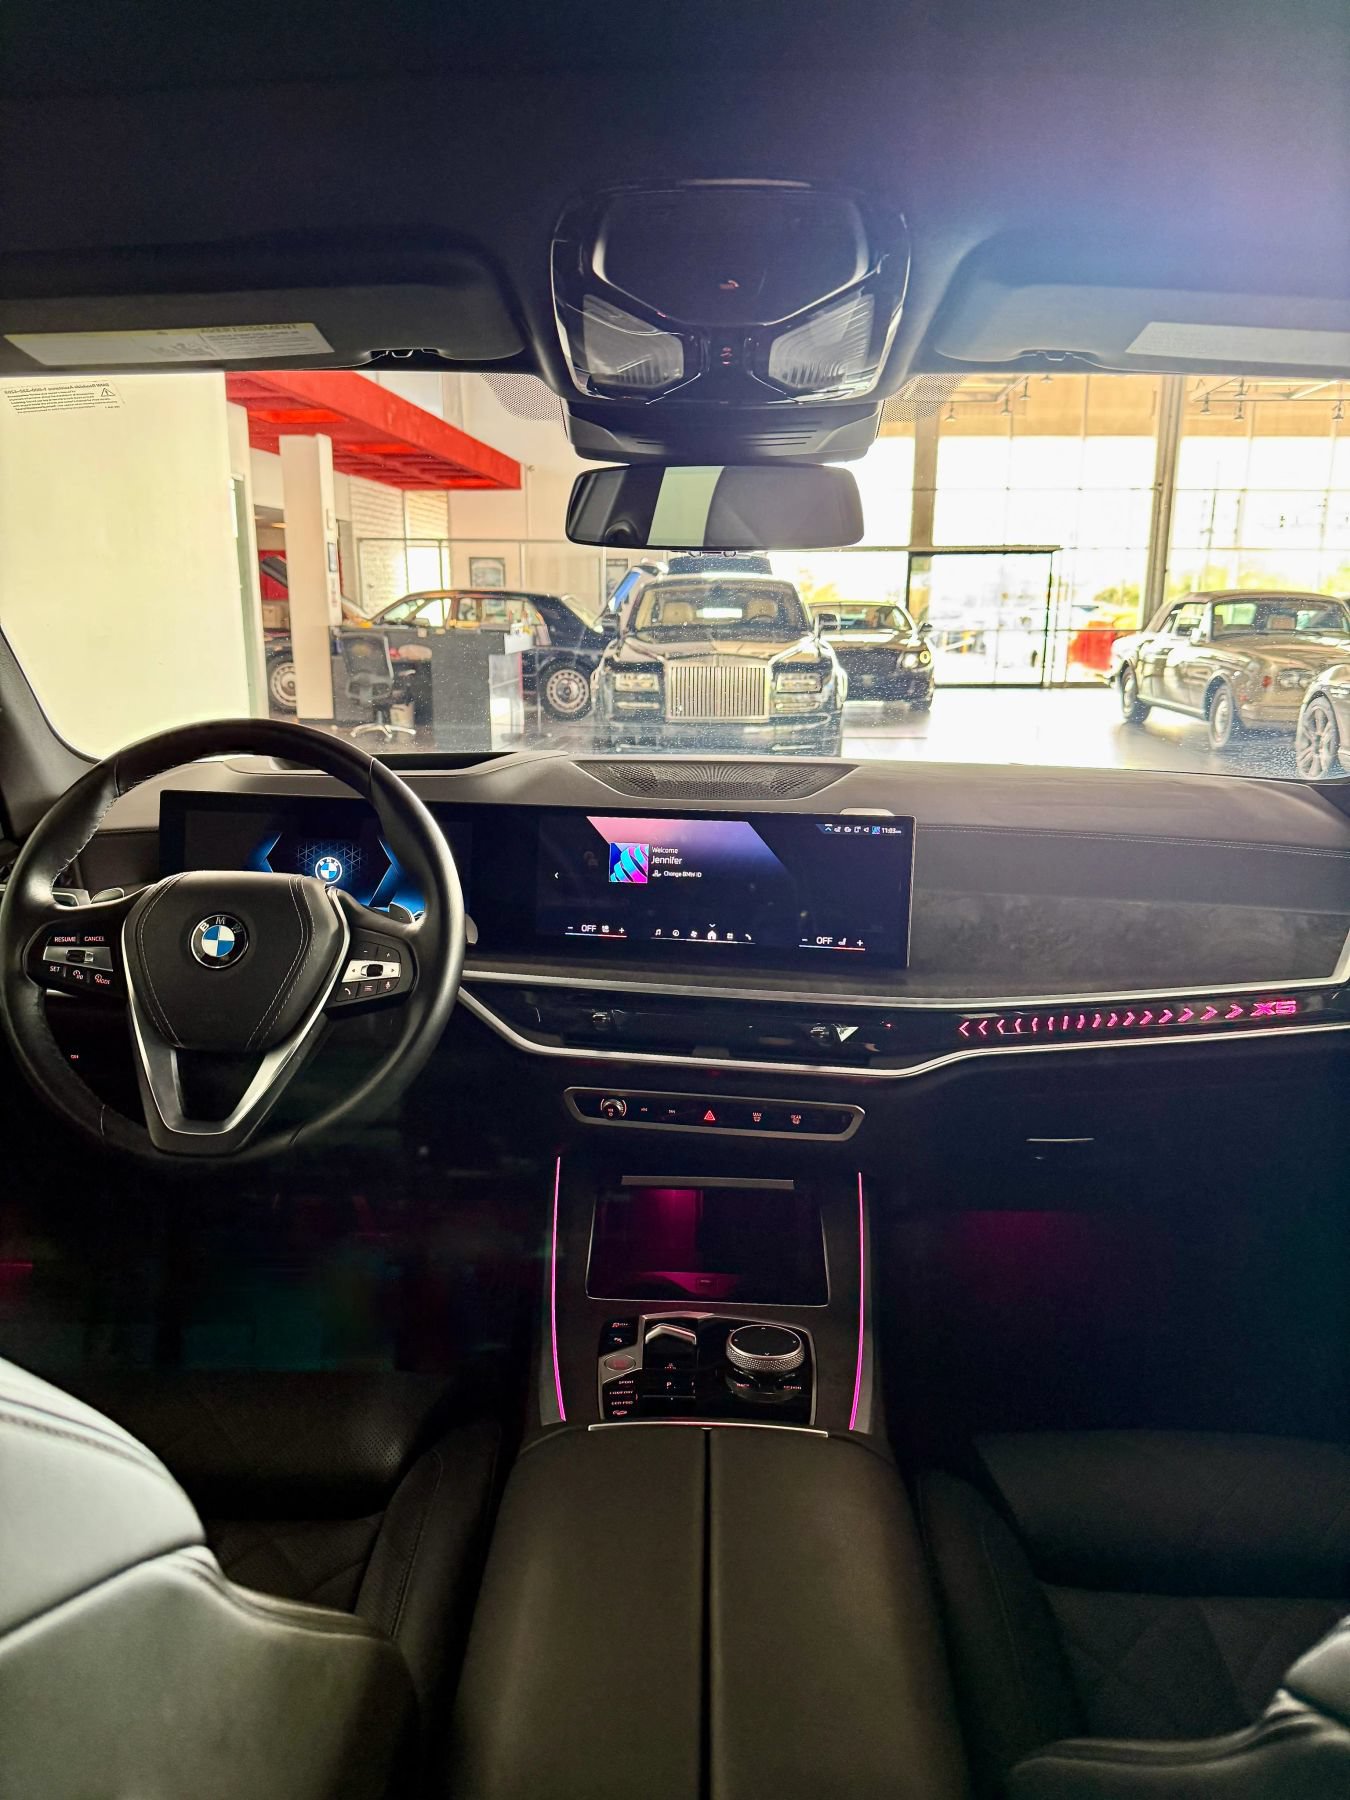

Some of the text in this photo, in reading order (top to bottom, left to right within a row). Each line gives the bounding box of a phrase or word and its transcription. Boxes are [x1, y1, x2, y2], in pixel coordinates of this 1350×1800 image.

[651, 846, 679, 854] Welcome
[650, 855, 683, 865] Jennifer
[199, 916, 243, 934] BMW
[581, 924, 597, 933] OFF
[816, 936, 833, 945] OFF
[1250, 1000, 1297, 1017] X5
